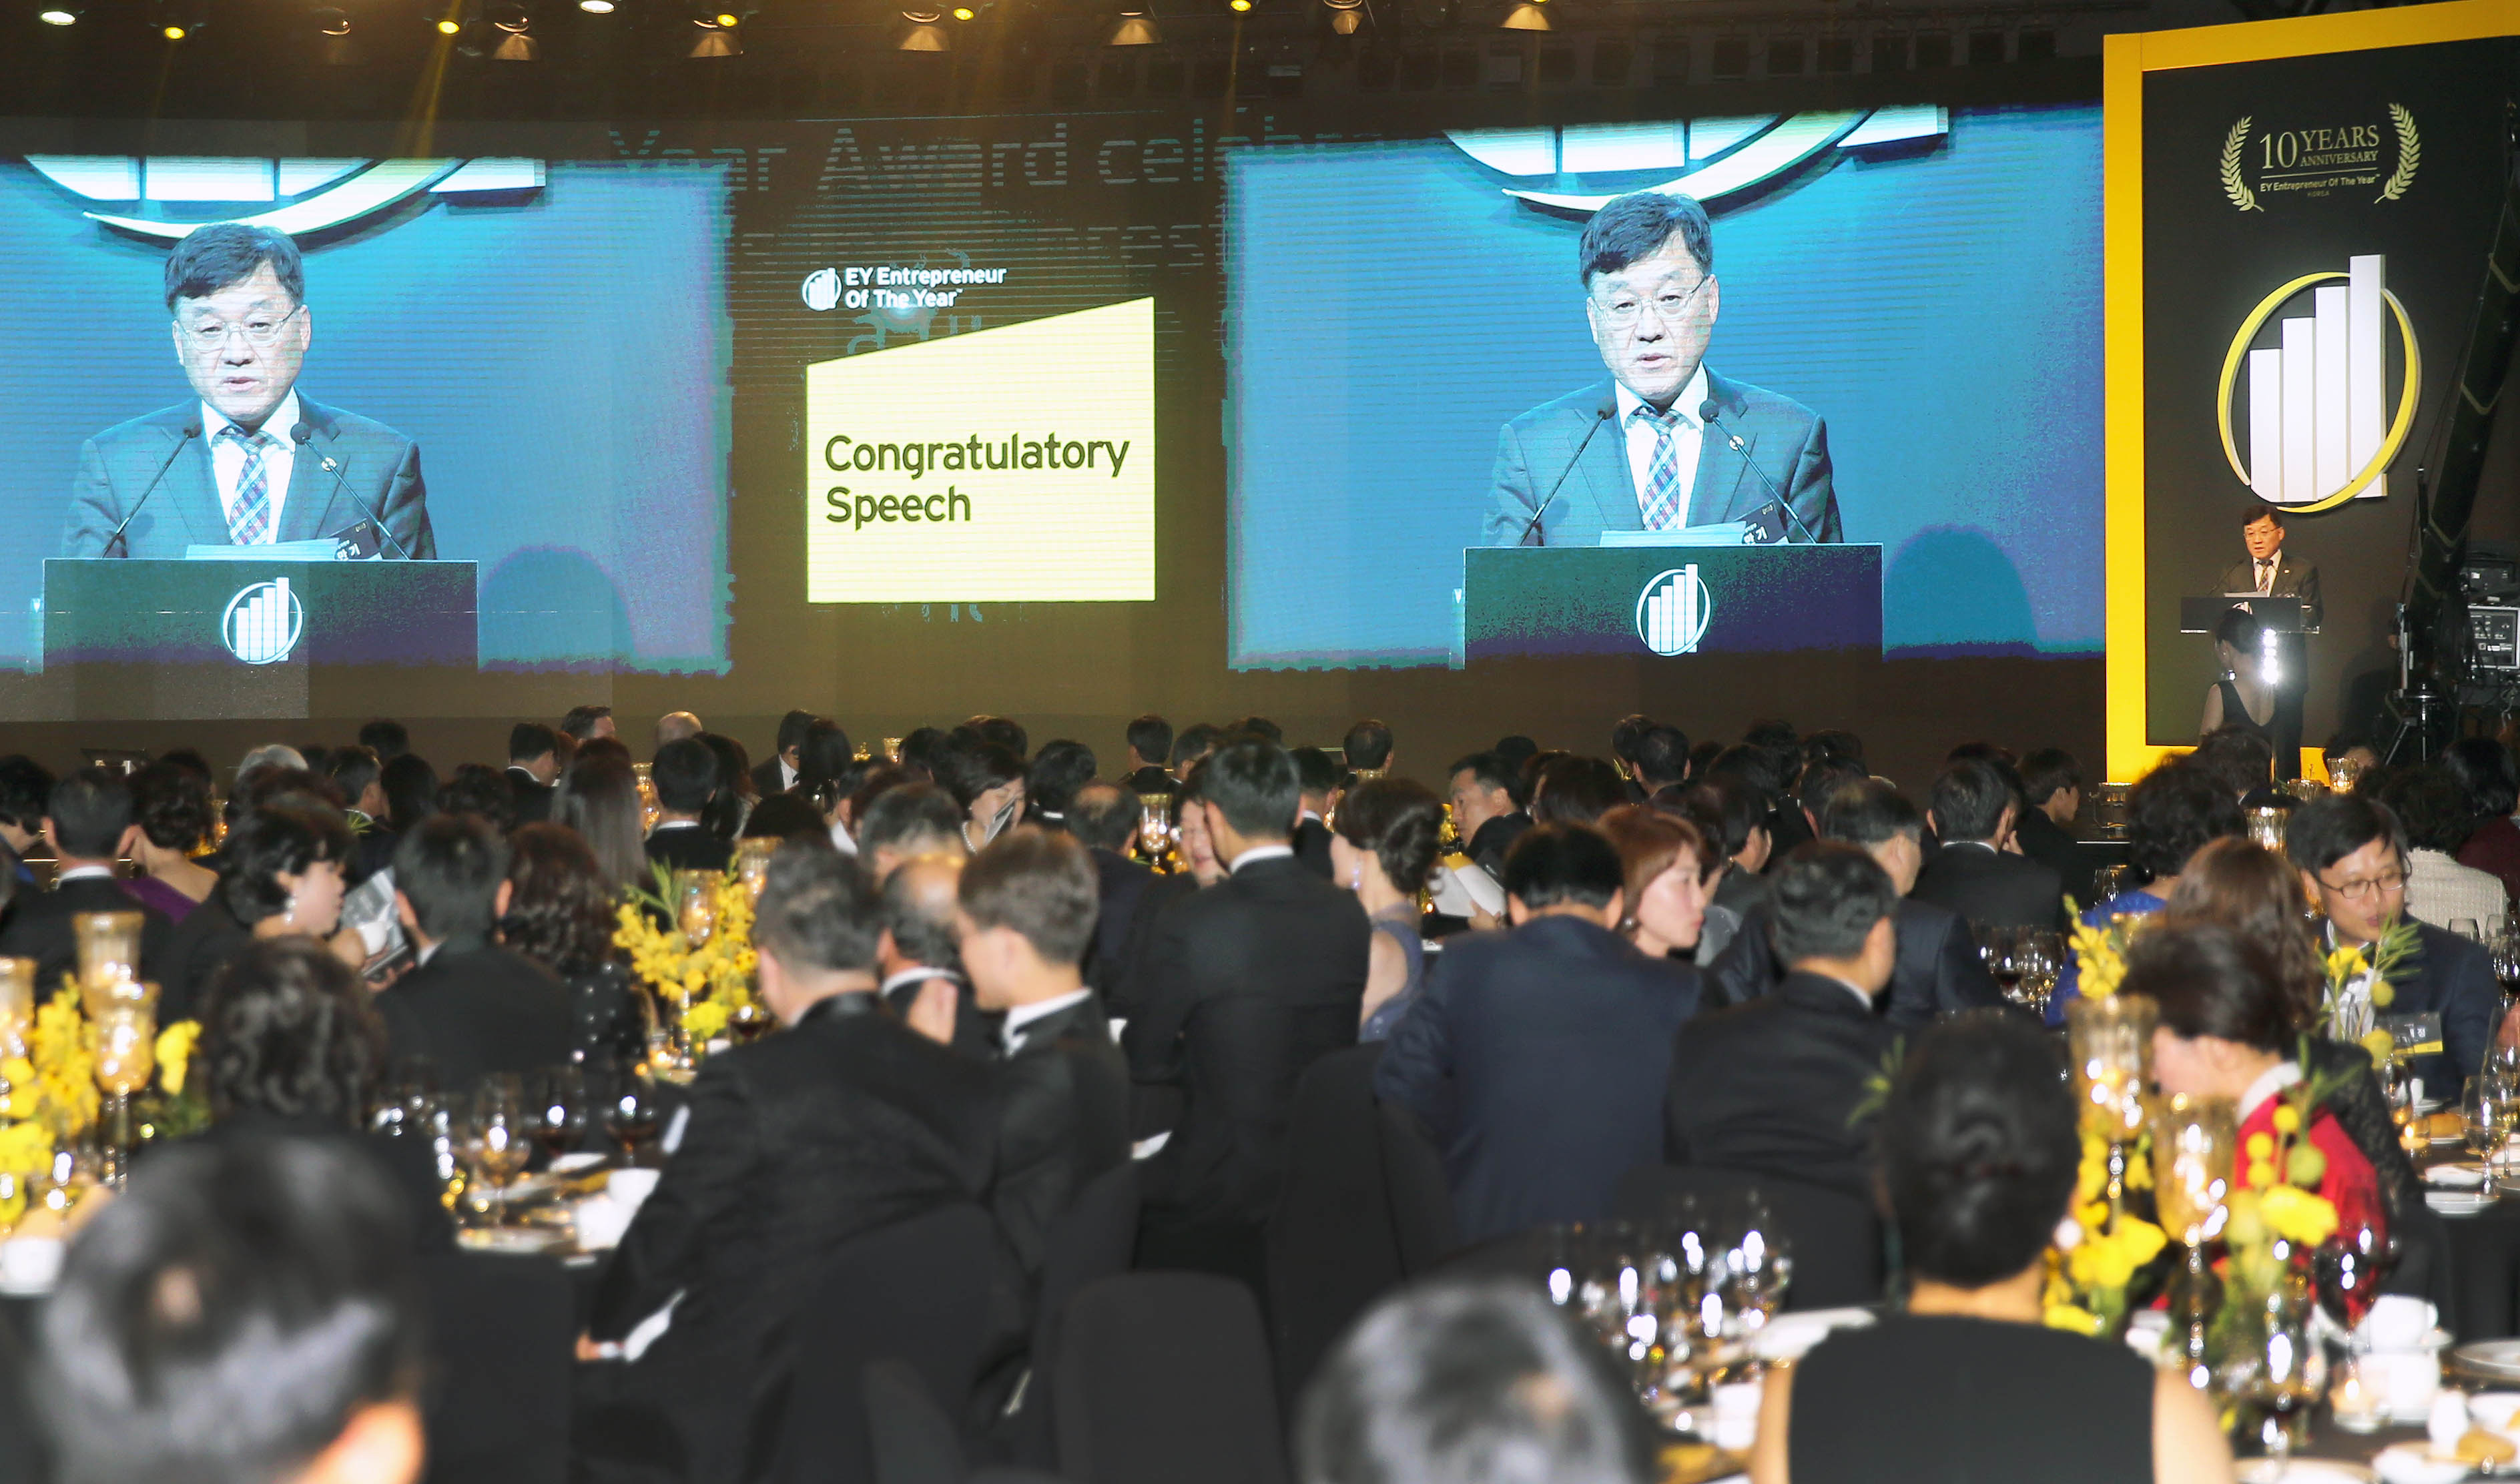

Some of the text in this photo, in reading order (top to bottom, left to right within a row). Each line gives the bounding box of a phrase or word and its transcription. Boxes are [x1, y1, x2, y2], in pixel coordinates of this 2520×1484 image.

[2259, 125, 2380, 169] 10 YEARS
[2300, 150, 2379, 167] ANNIVERSARY
[2260, 181, 2274, 192] EY
[2273, 178, 2327, 192] Entrepreneur
[2328, 179, 2338, 188] Of
[2340, 177, 2356, 186] The
[844, 266, 1007, 288] EY Entrepreneur
[844, 289, 870, 309] Of
[872, 288, 909, 308] The
[825, 432, 1131, 480] Congratulatory
[826, 484, 972, 531] Speech
